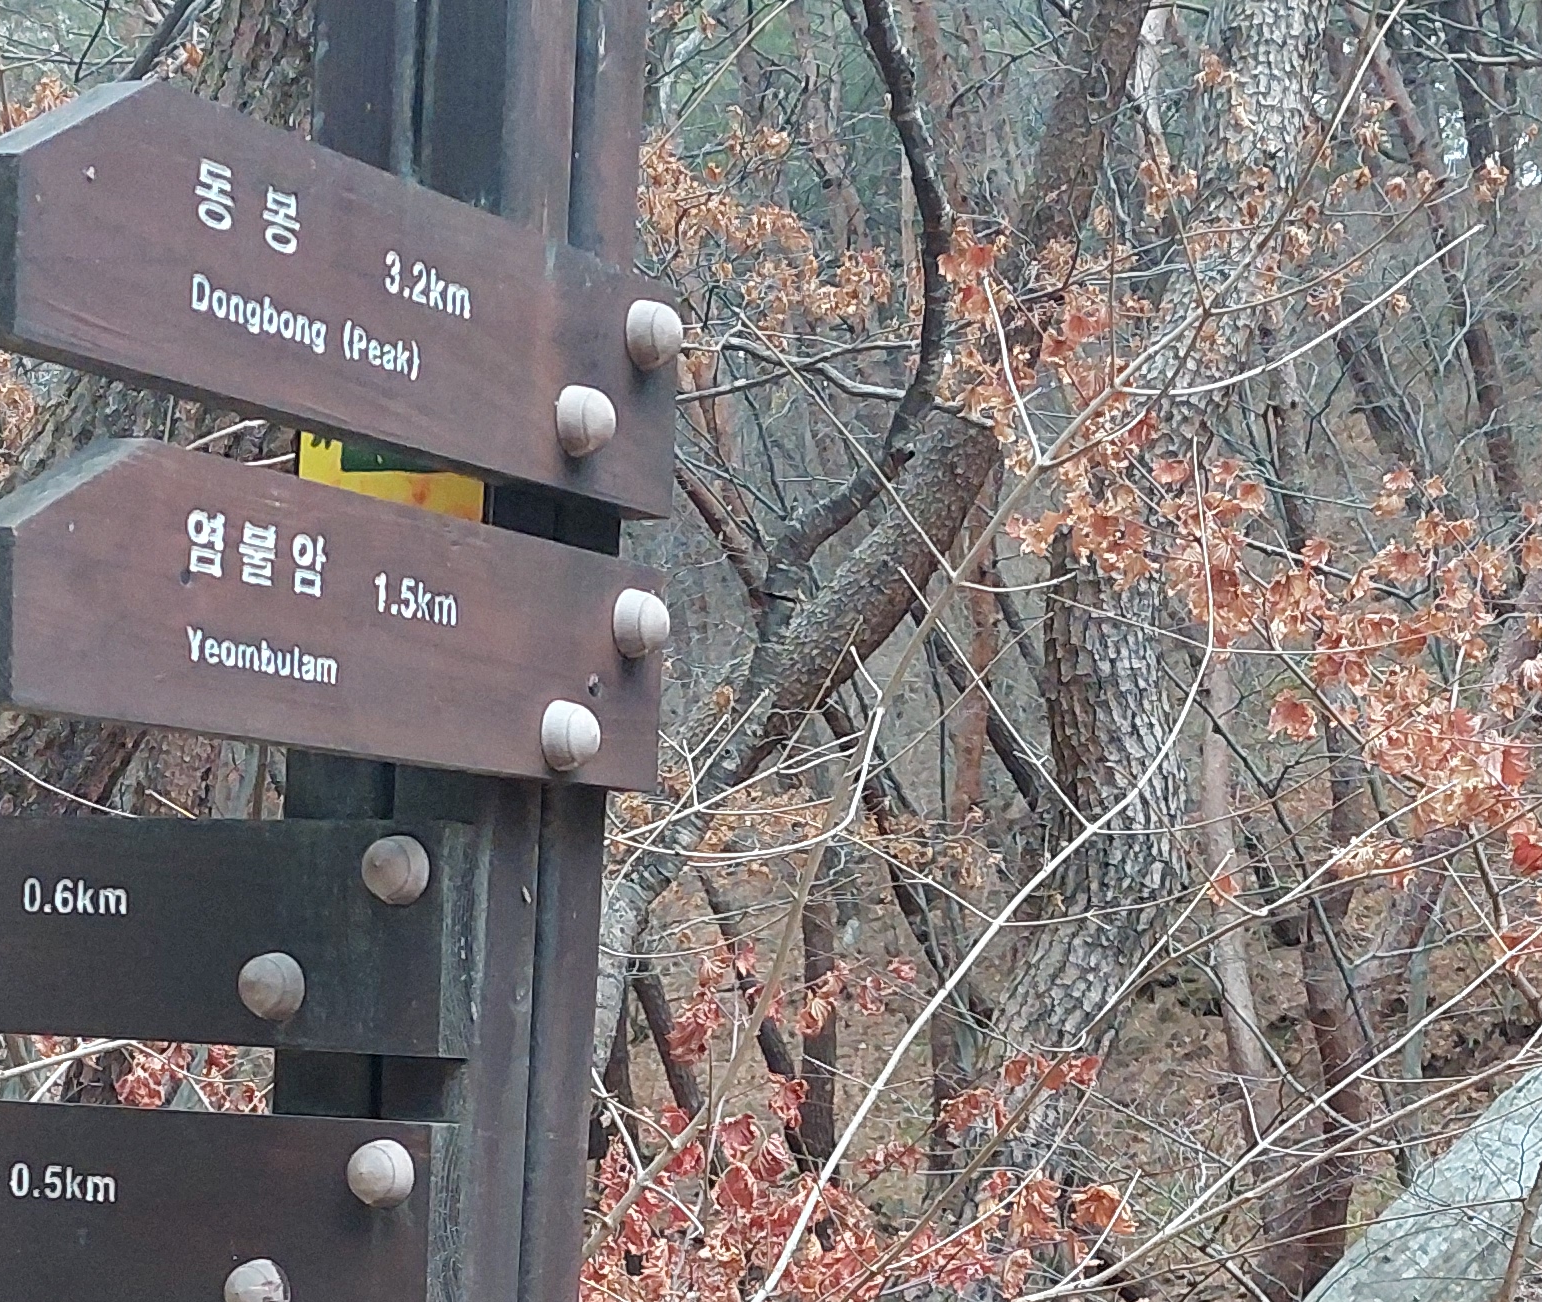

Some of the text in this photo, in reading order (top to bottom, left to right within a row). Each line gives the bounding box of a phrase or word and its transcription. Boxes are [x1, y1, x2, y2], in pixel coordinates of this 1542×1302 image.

[384, 250, 471, 320] 3.2km
[191, 273, 420, 381] Dongbong (Peak)
[374, 572, 457, 626] 1.5km
[186, 625, 338, 685] Yeombulam
[23, 877, 127, 915] 0.6km
[9, 1162, 116, 1203] 0.5km
